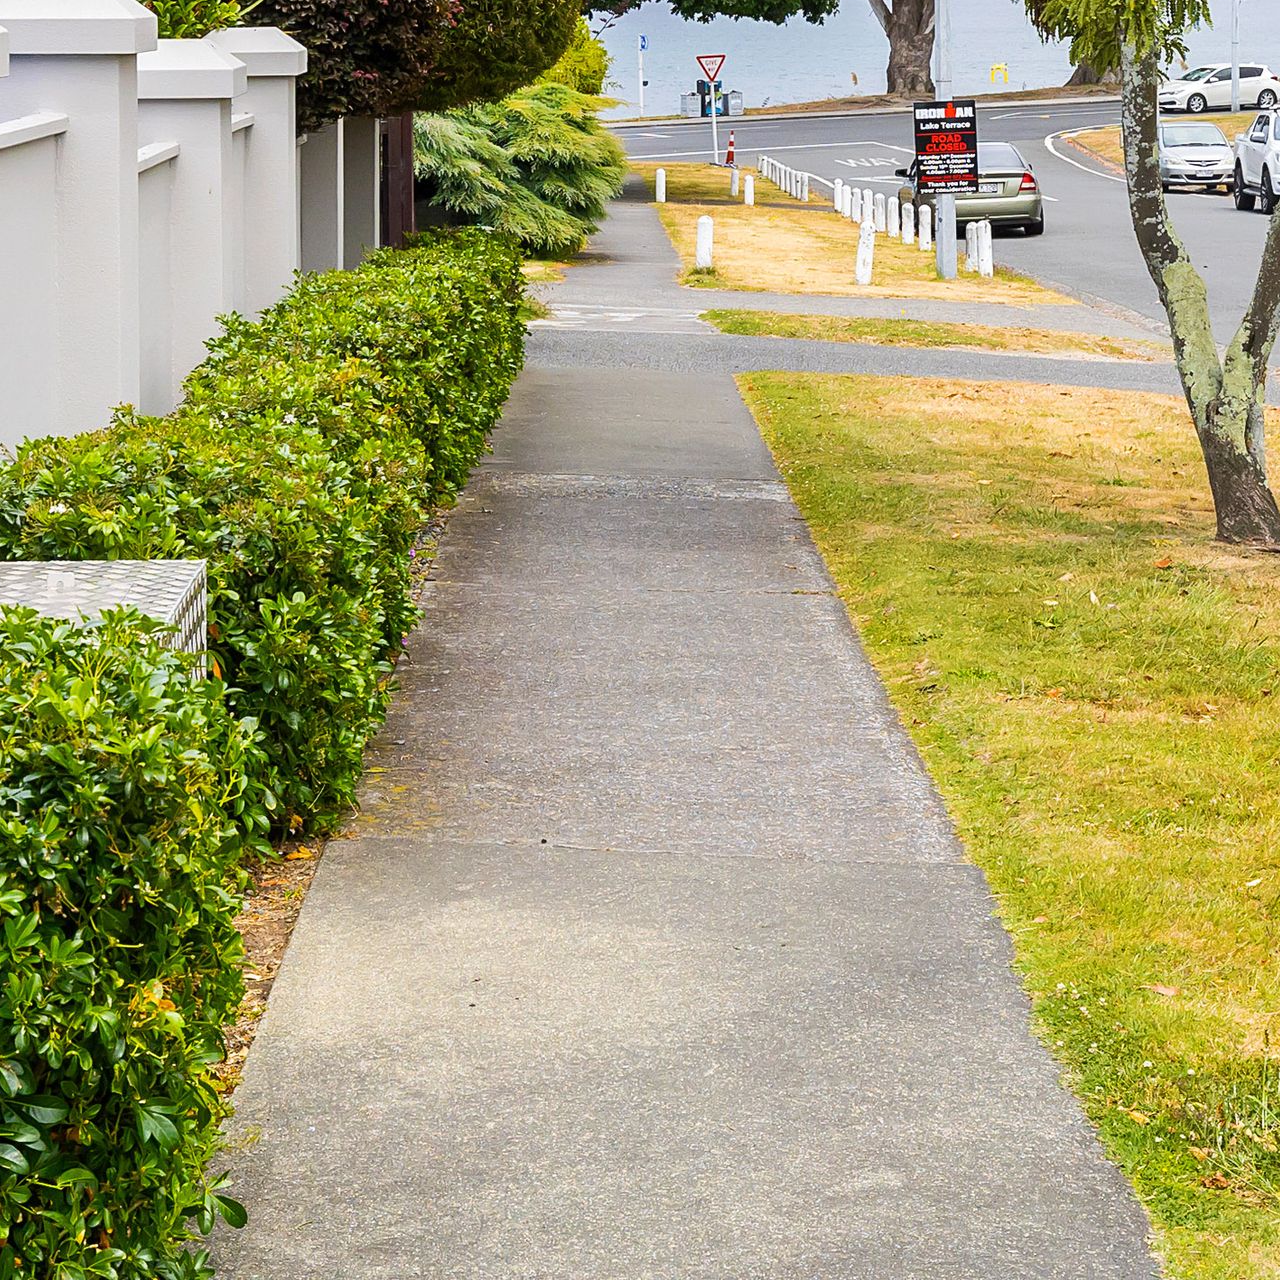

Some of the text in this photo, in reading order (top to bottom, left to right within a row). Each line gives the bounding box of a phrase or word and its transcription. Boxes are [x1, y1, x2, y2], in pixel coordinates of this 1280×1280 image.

[915, 103, 975, 120] IRONMAN
[920, 121, 971, 130] Lake Terrace
[931, 133, 962, 143] ROAD
[925, 141, 967, 152] CLOSED
[834, 157, 902, 168] WAY
